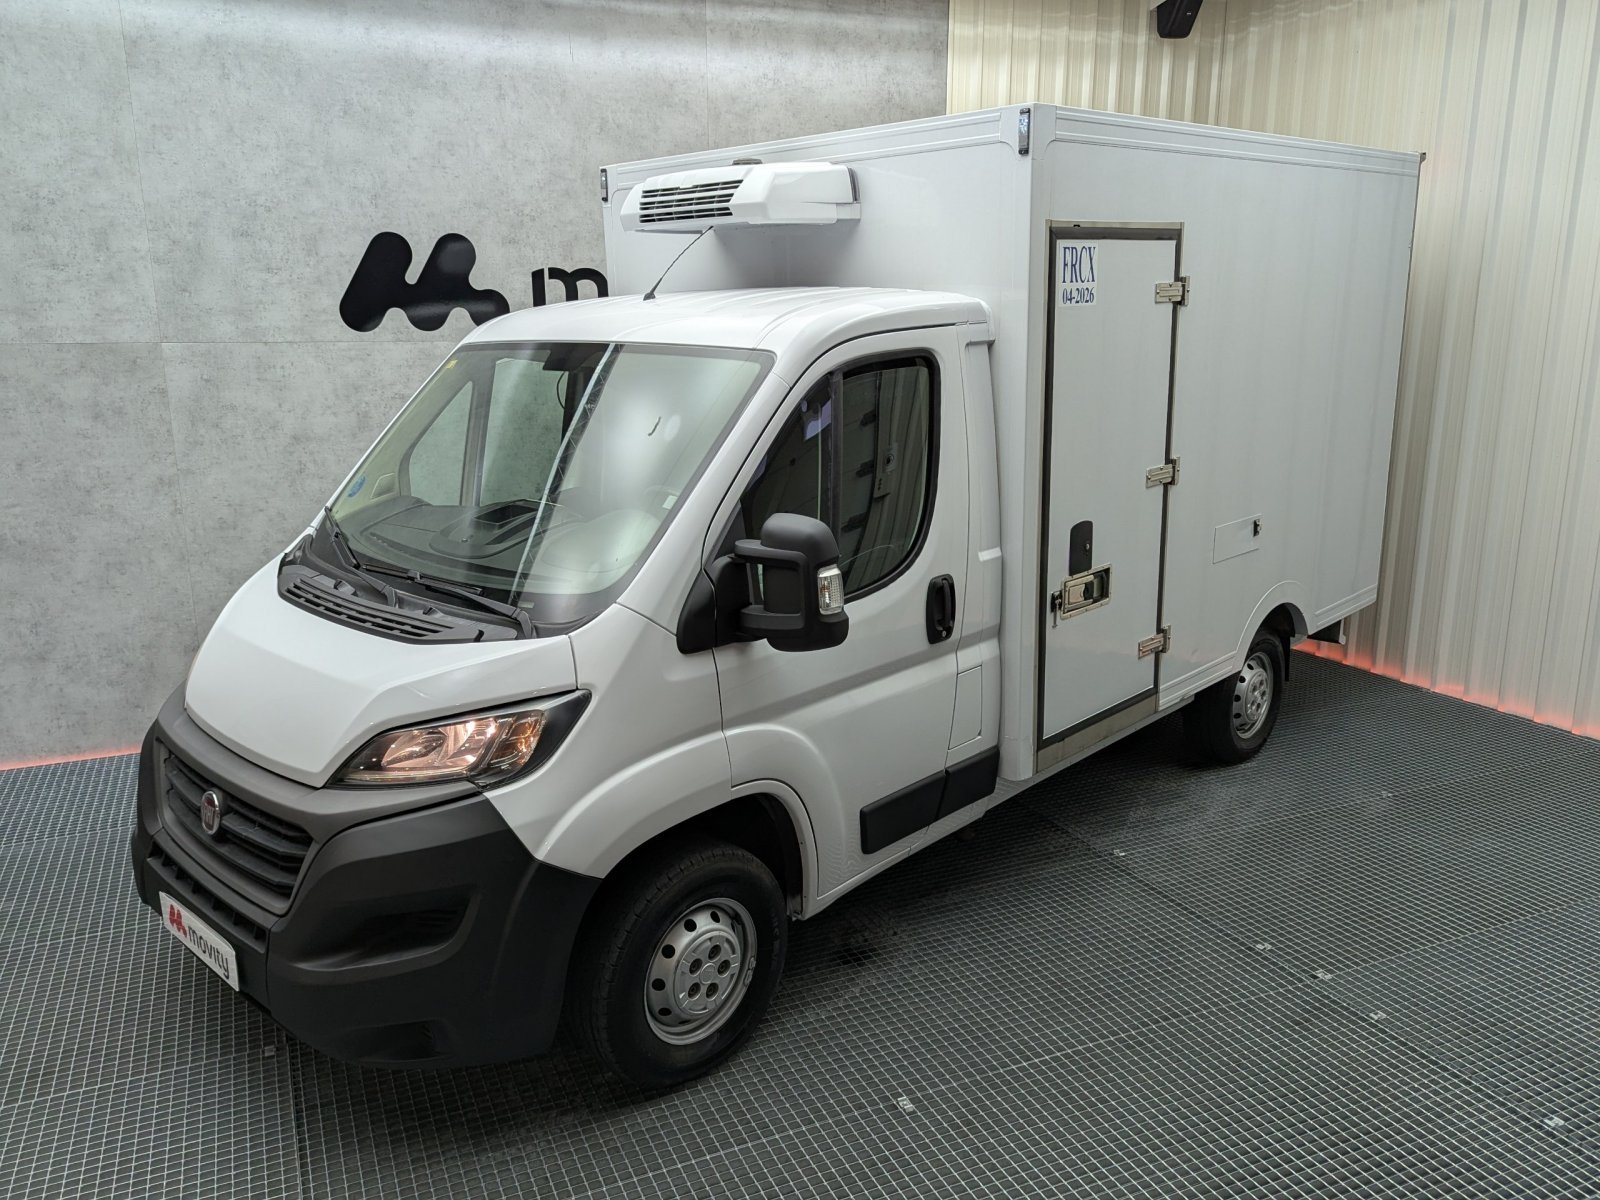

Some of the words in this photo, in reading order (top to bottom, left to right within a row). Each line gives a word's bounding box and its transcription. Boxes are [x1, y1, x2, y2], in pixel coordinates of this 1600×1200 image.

[1062, 246, 1096, 283] FRCX
[1062, 287, 1095, 304] 04-2026
[188, 925, 229, 980] movity
